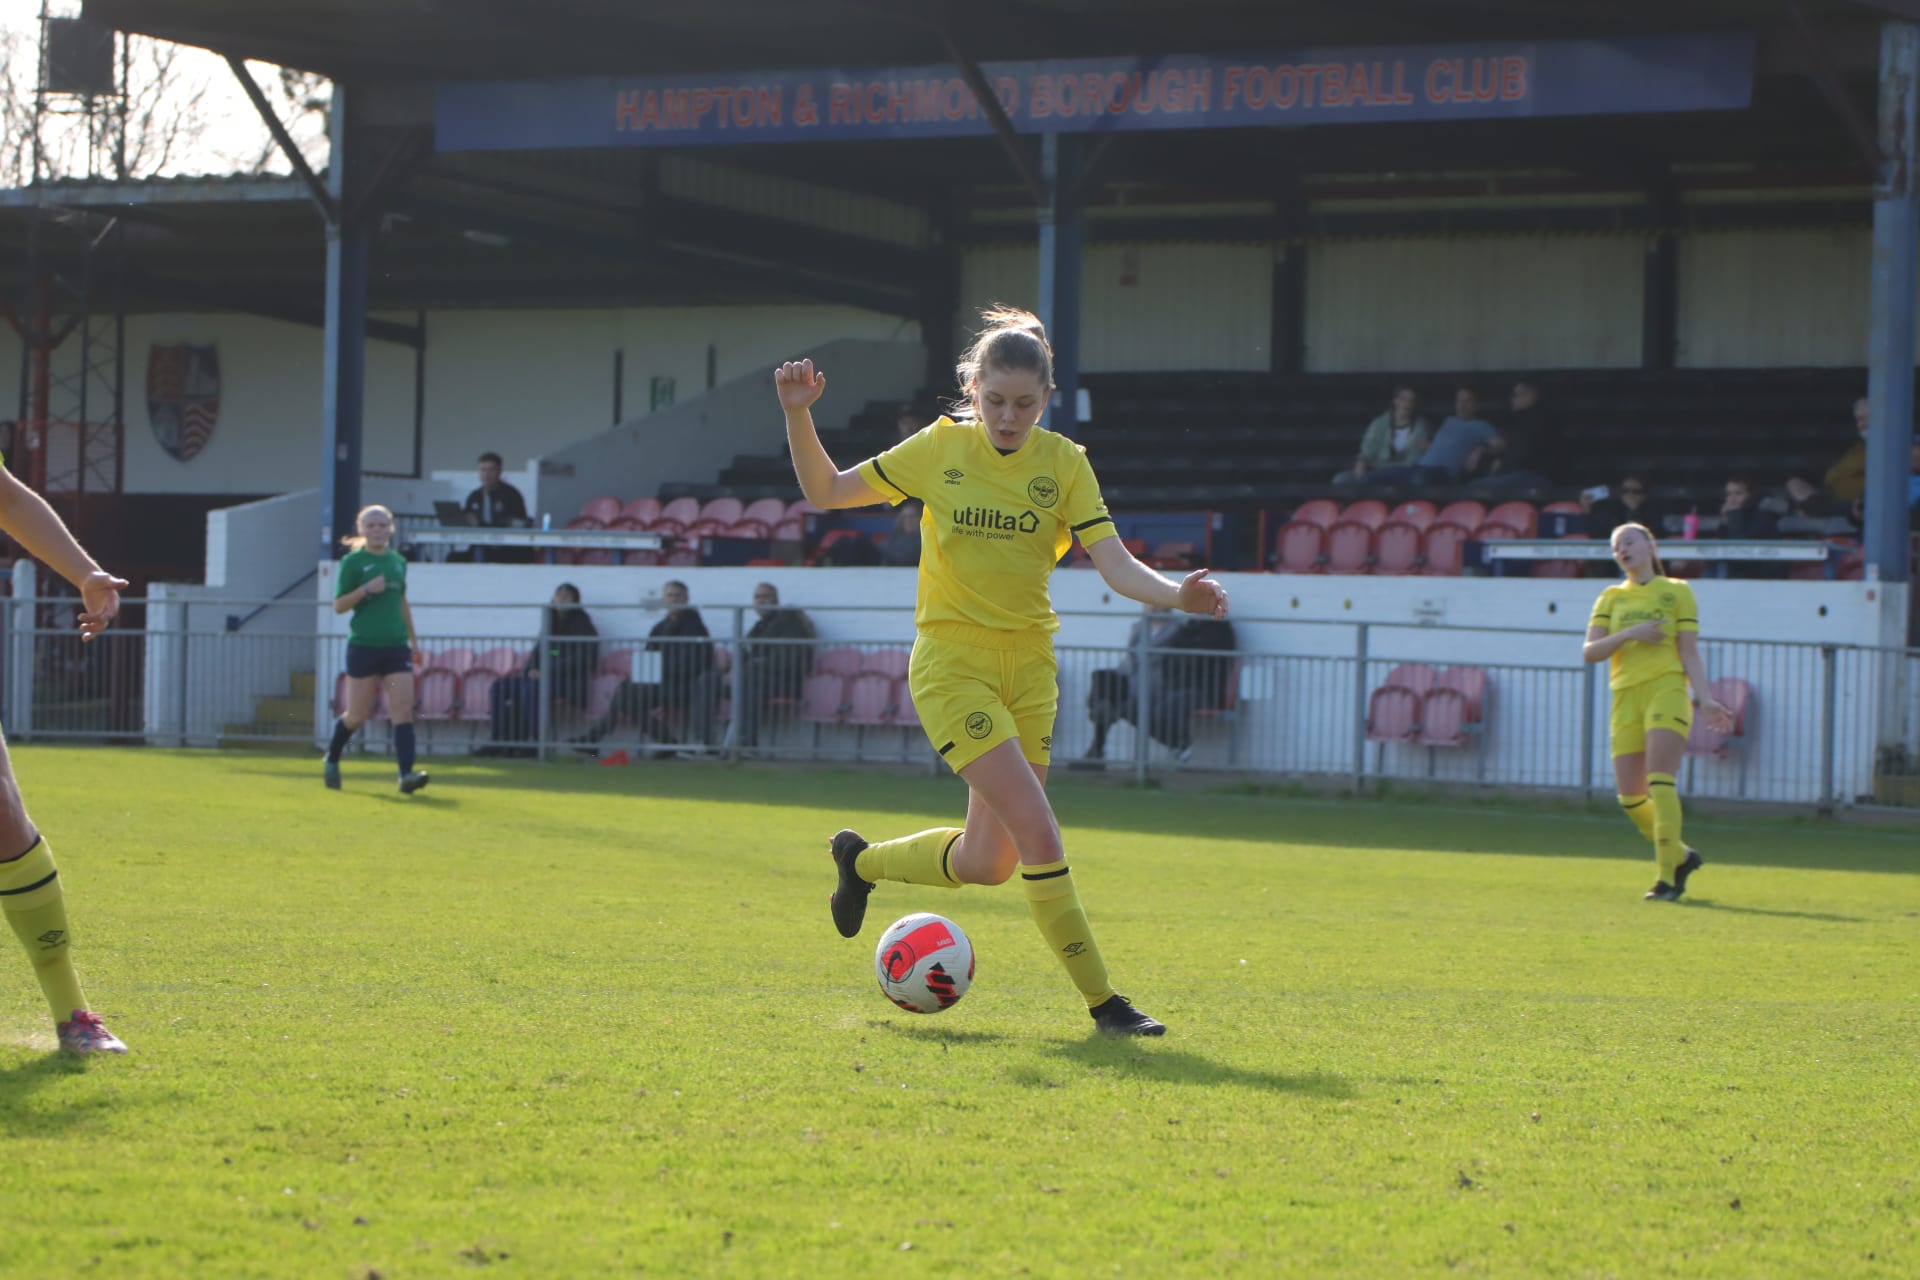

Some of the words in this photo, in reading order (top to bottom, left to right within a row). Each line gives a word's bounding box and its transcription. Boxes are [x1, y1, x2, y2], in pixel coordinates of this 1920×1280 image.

[616, 86, 783, 130] HAMPTON
[794, 83, 819, 126] &
[1030, 70, 1209, 117] BOROUGH
[1223, 62, 1412, 109] FOOTBALL
[1426, 57, 1526, 101] CLUB
[953, 506, 1017, 531] utilita
[952, 526, 964, 535] life
[966, 529, 985, 537] with
[986, 532, 1015, 541] power
